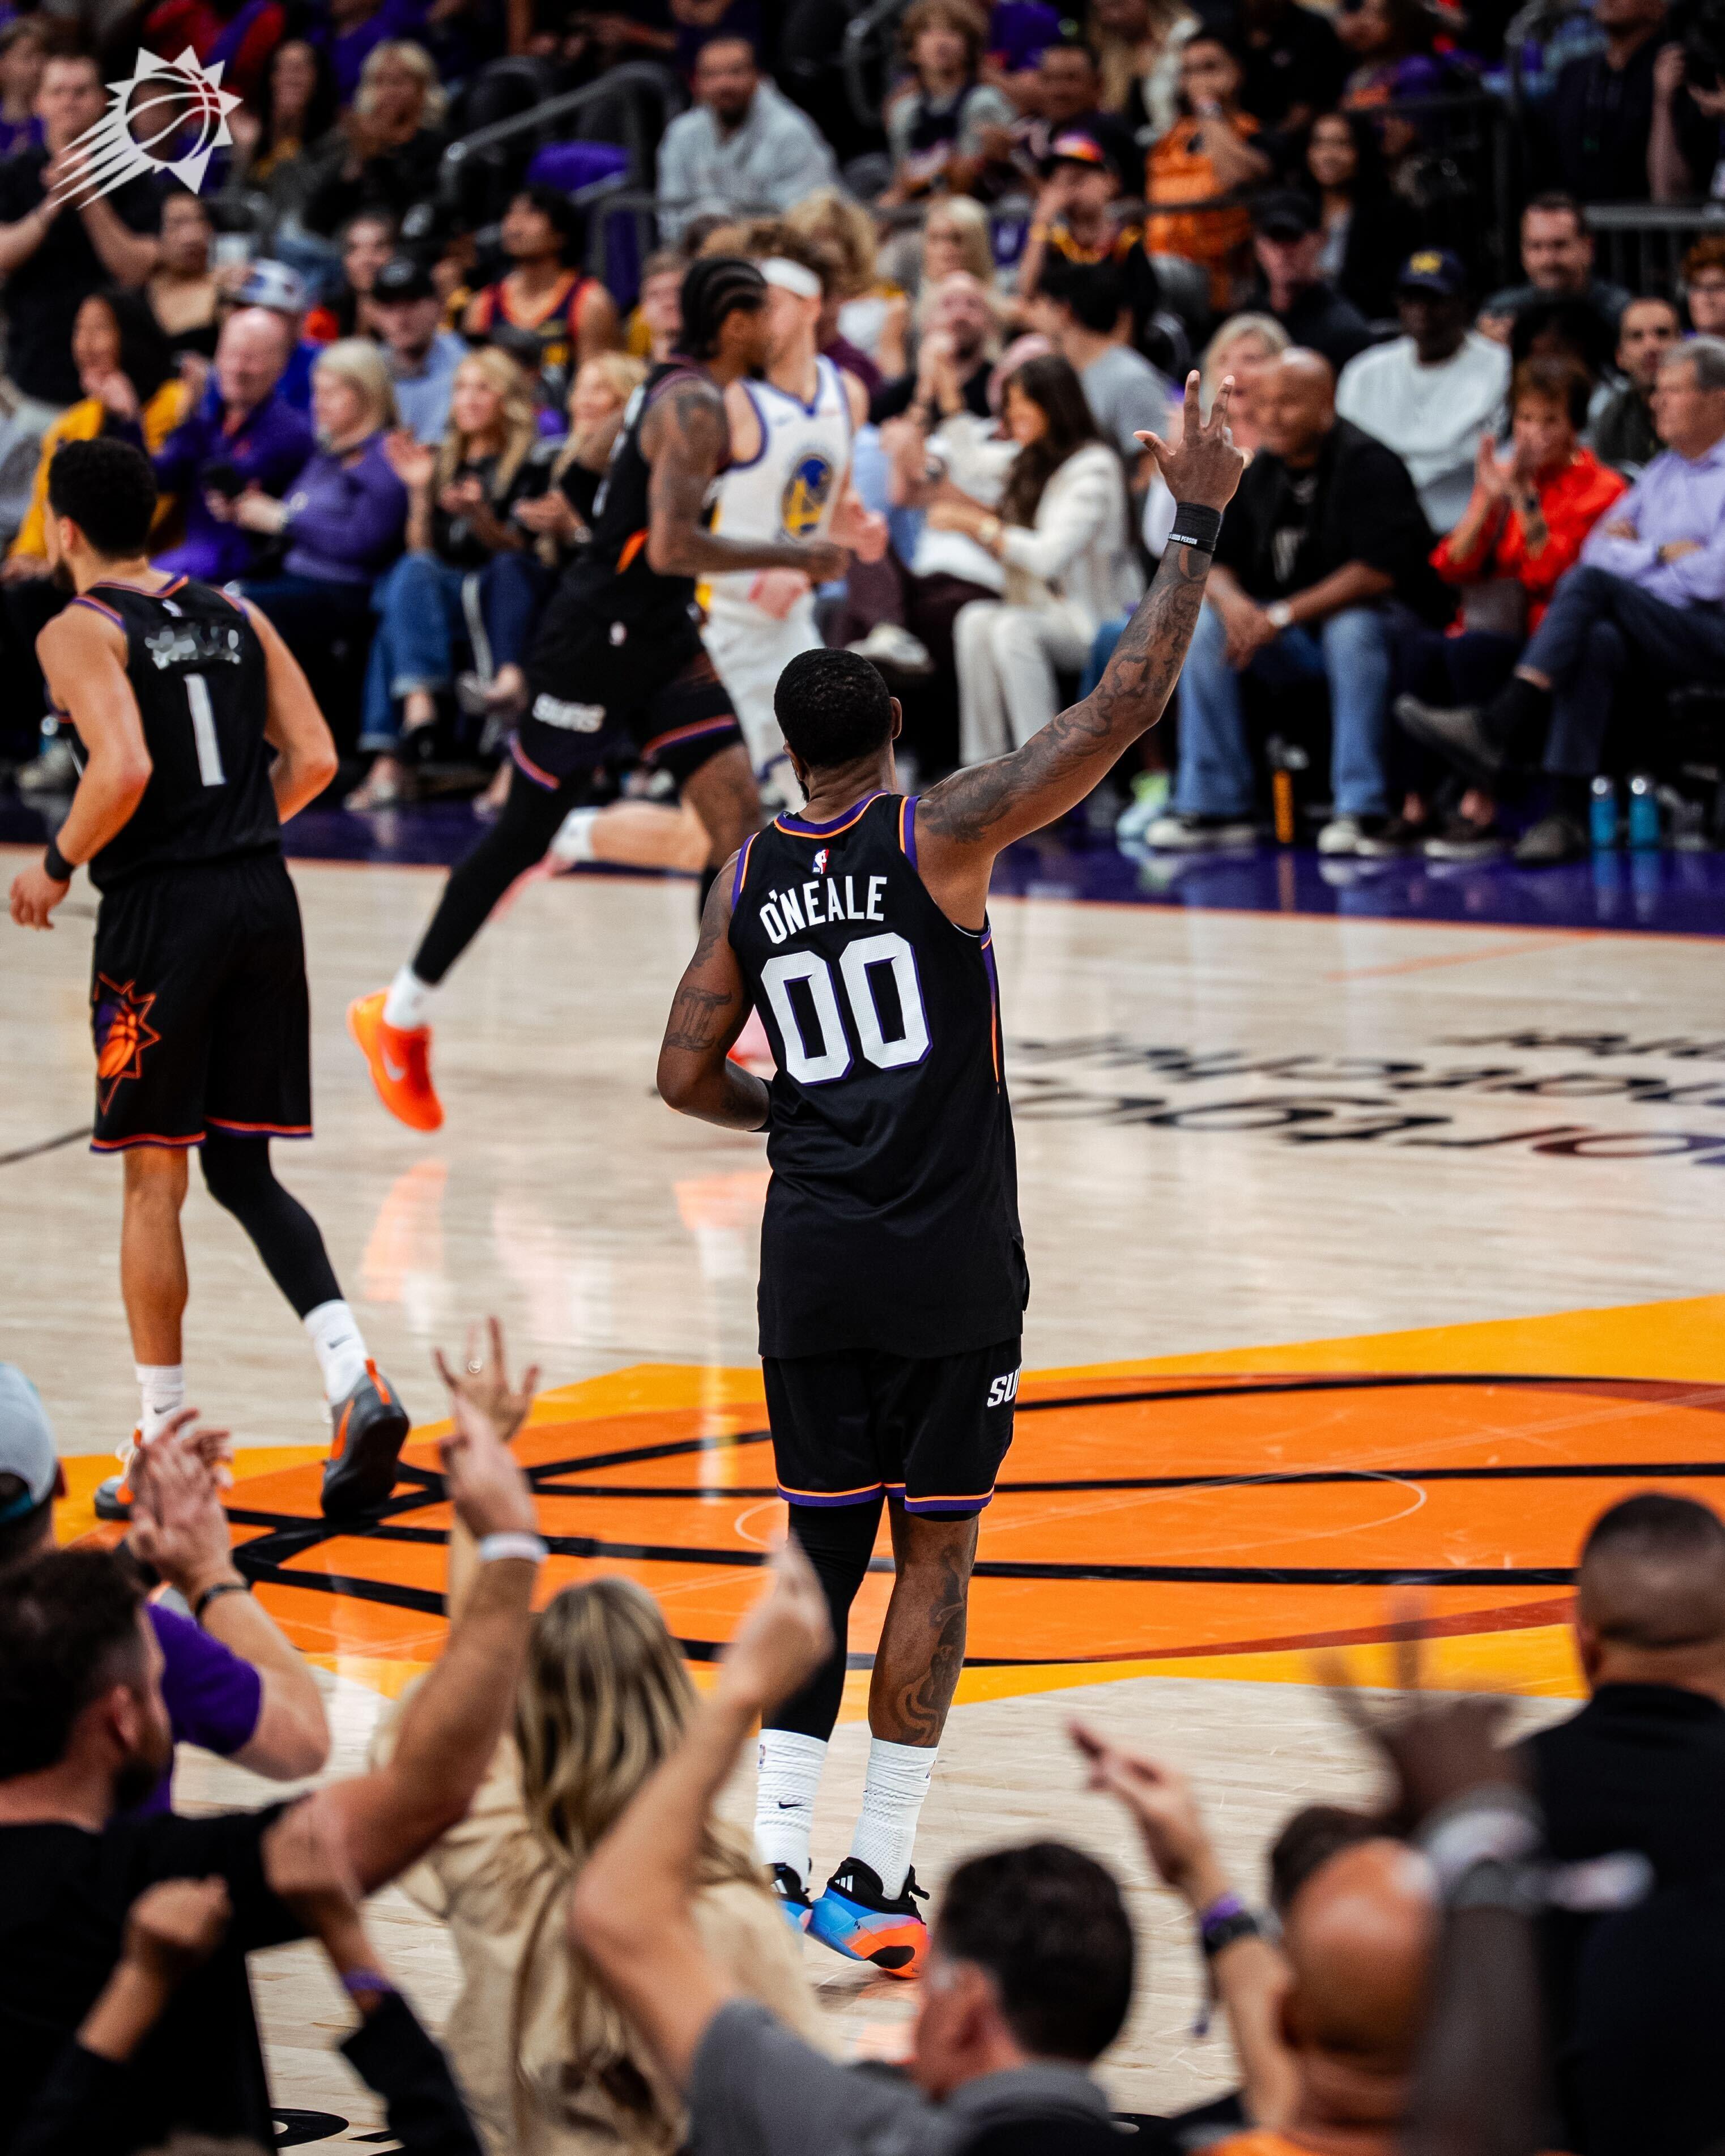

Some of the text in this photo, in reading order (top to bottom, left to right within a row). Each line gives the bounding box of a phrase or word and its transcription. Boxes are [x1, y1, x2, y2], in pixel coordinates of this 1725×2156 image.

[184, 674, 227, 786] 1
[759, 876, 887, 944] O'NEALE
[761, 932, 933, 1086] 00
